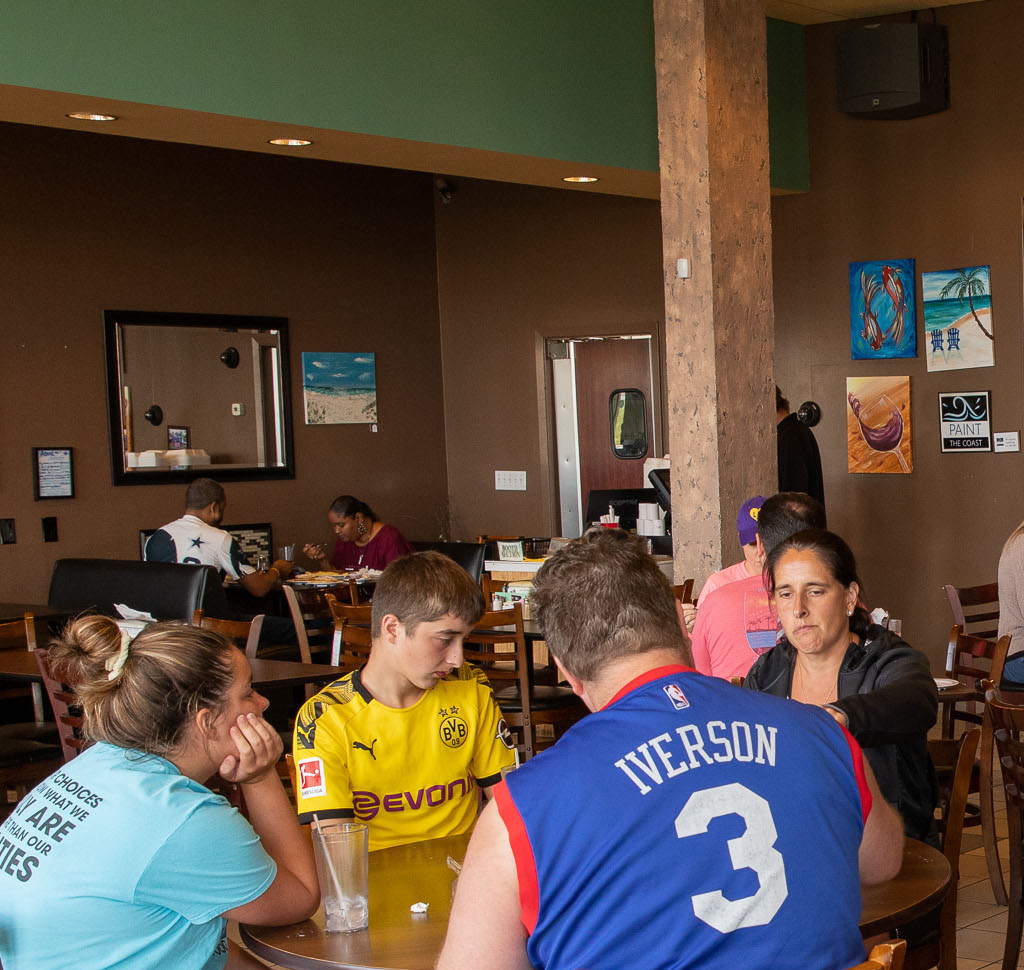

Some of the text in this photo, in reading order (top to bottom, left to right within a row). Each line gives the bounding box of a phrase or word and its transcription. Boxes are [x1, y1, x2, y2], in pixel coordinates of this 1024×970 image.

[949, 423, 982, 436] PAINT
[962, 439, 982, 447] COAST
[442, 719, 467, 743] BVB
[614, 720, 779, 796] IVERSON
[43, 787, 73, 811] WHAT
[69, 804, 90, 822] WE
[53, 773, 103, 808] CHOICES
[9, 820, 29, 842] THAN
[26, 836, 53, 857] OUR
[24, 806, 77, 843] ARE
[0, 835, 40, 883] TIES
[673, 782, 789, 935] 3
